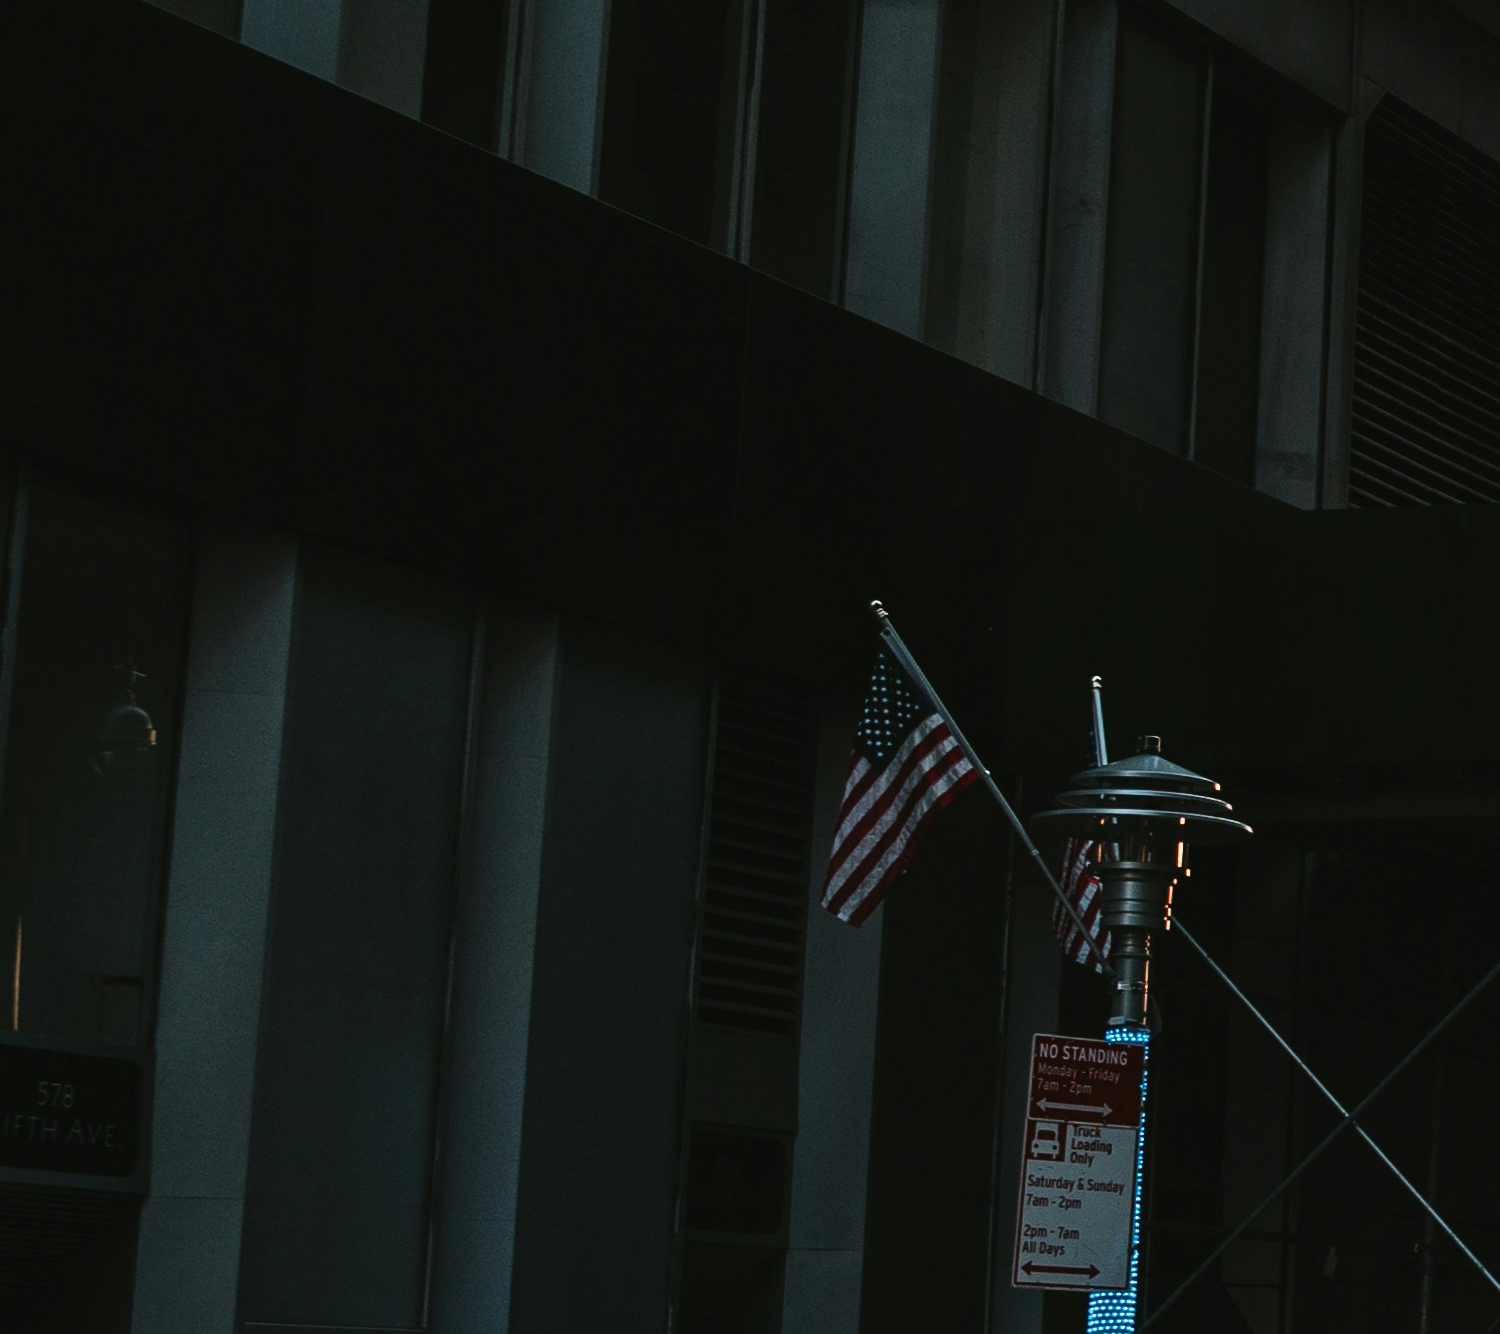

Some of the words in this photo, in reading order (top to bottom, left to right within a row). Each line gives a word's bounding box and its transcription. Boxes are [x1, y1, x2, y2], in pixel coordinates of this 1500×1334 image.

[1039, 1043, 1059, 1061] NO
[1062, 1046, 1129, 1067] STANDING
[1037, 1063, 1079, 1081] Monday
[1088, 1068, 1121, 1084] Friday
[37, 1081, 75, 1109] 578
[1037, 1078, 1059, 1094] 7am
[1069, 1081, 1093, 1096] 2pm
[0, 1113, 58, 1142] IFTH
[1072, 1125, 1102, 1138] Truck
[1071, 1138, 1113, 1156] Loading
[1070, 1152, 1094, 1167] Only
[1027, 1175, 1075, 1191] Saturday
[1077, 1178, 1085, 1191] &
[1087, 1178, 1125, 1195] Sunday
[1026, 1195, 1049, 1208] 7am
[1058, 1196, 1082, 1210] 2pm
[1023, 1225, 1048, 1240] 2pm
[1058, 1227, 1080, 1239] 7am
[1022, 1241, 1037, 1255] All
[1039, 1242, 1066, 1257] Days
